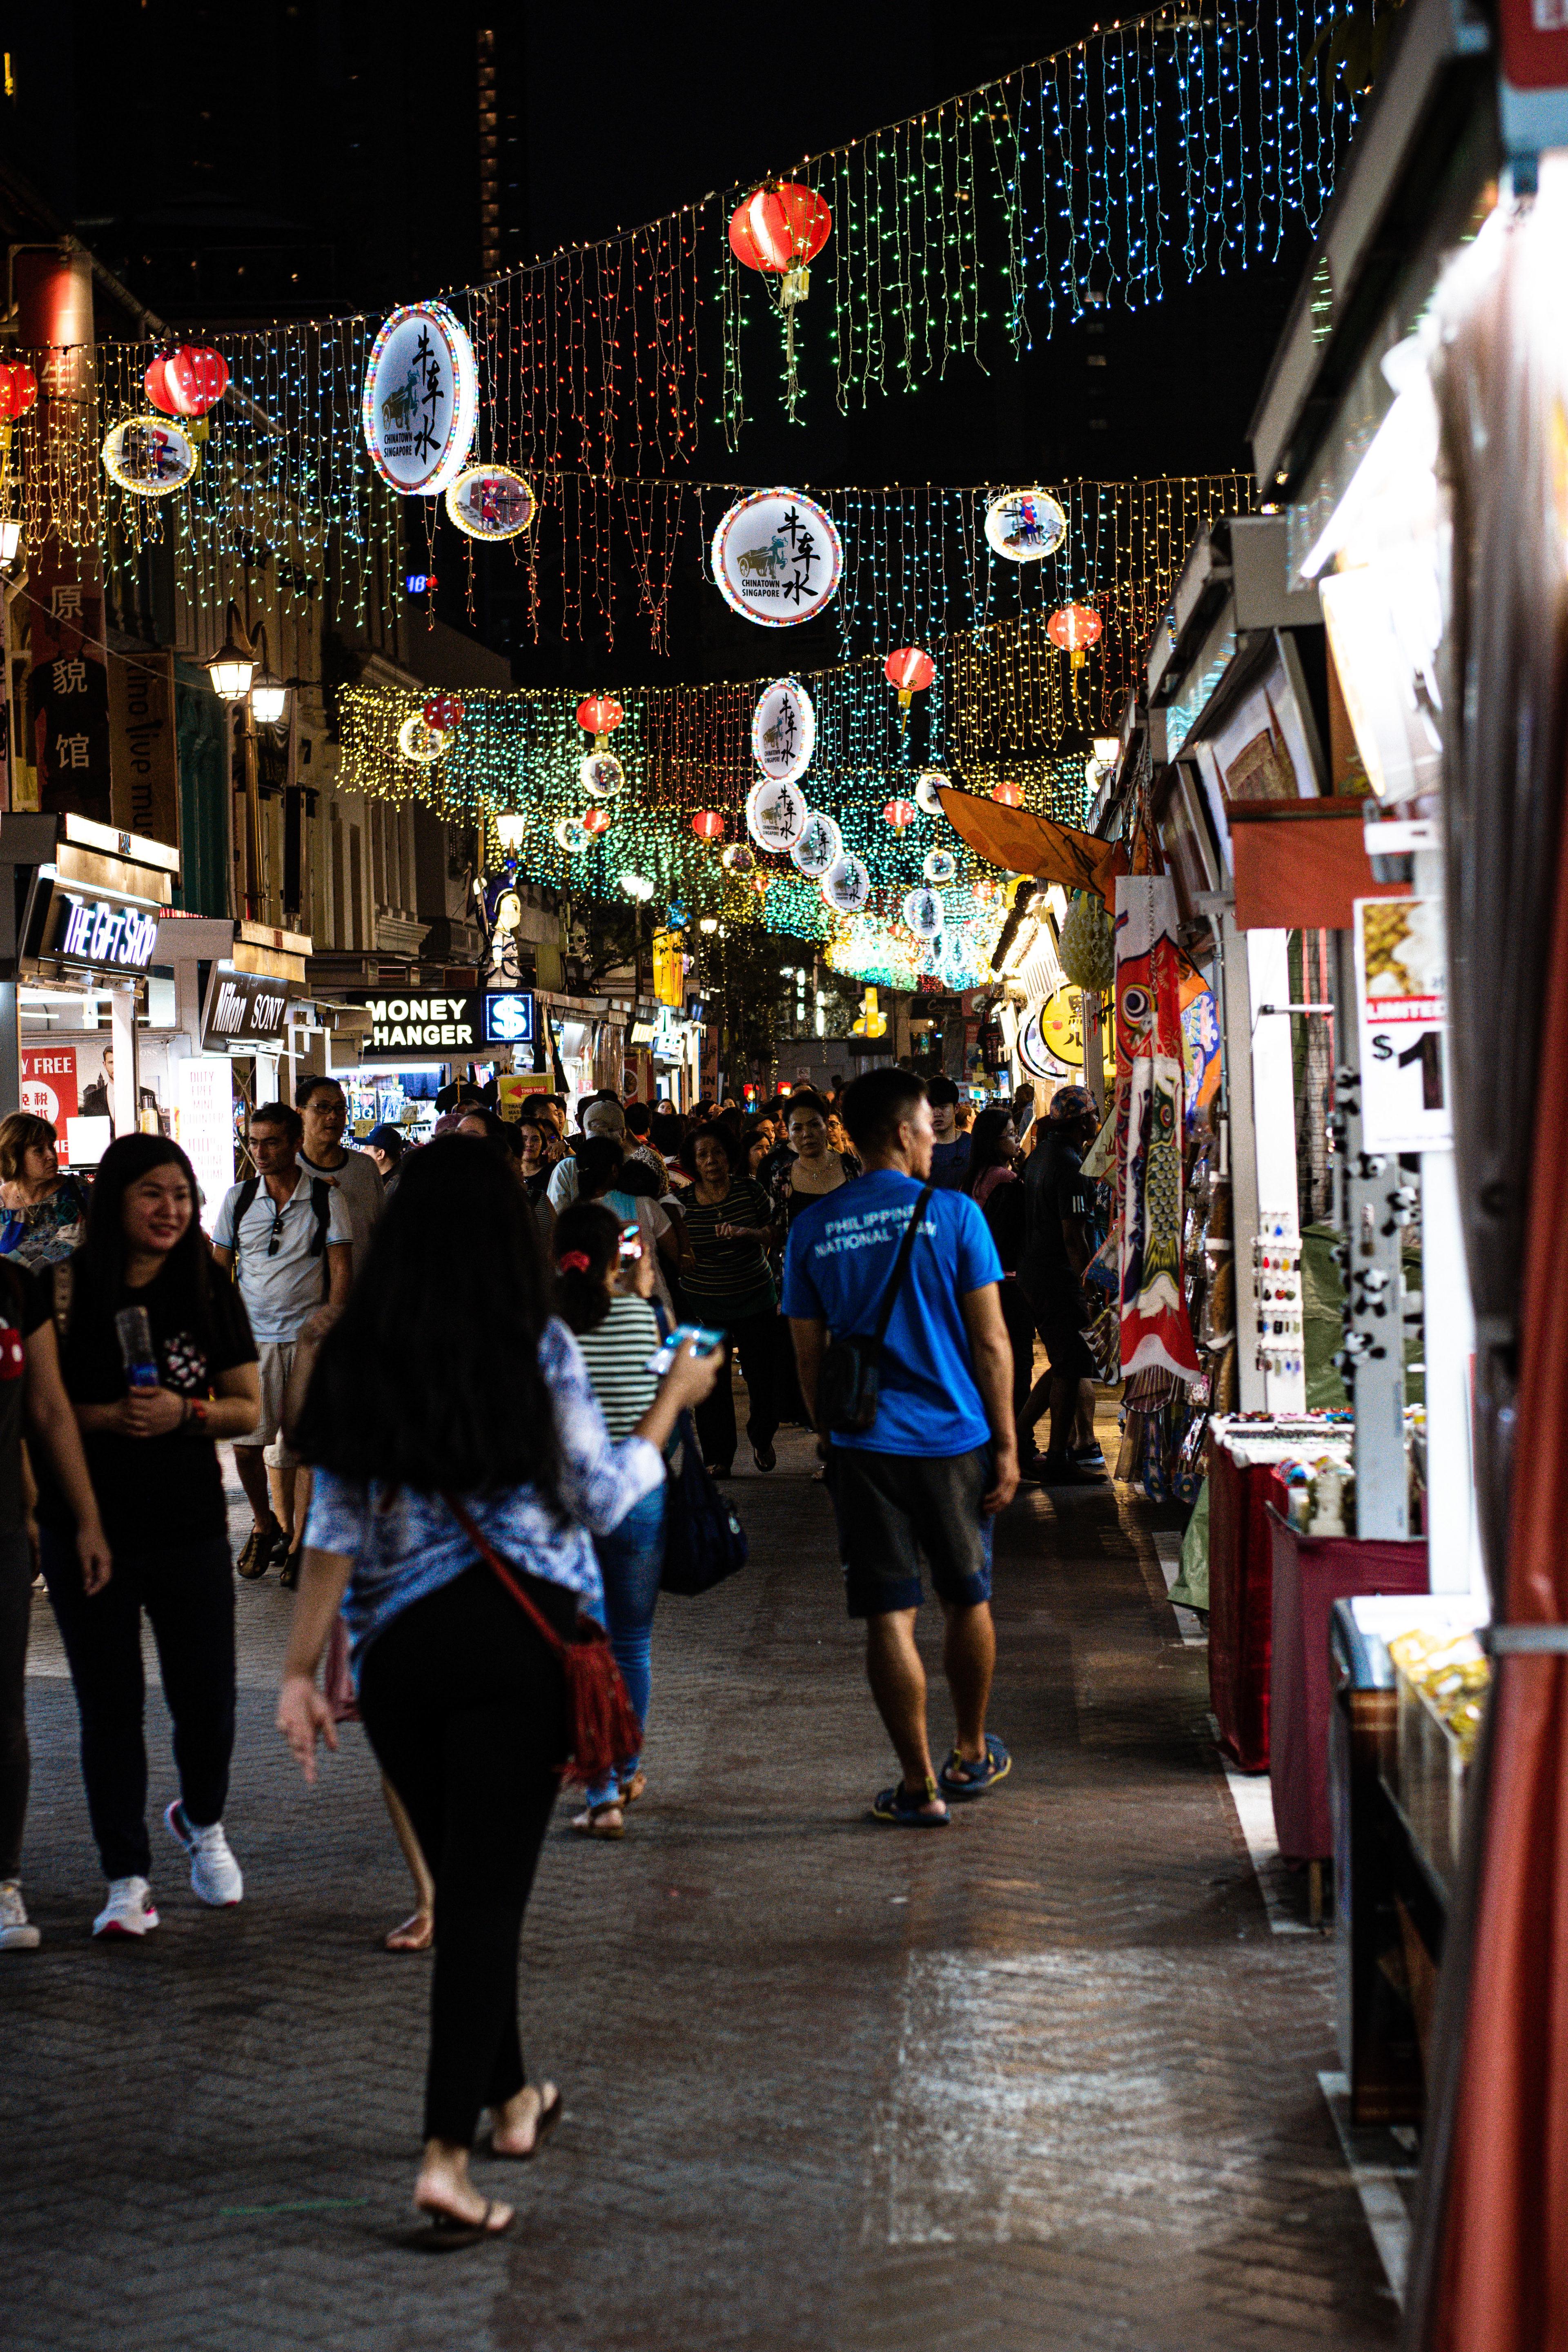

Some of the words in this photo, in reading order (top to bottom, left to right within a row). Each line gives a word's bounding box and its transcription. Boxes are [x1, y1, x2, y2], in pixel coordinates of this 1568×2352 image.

[412, 325, 444, 465] 牛车水
[384, 432, 412, 445] CHINATOWN
[384, 445, 412, 458] SINGAPORE
[777, 506, 820, 606] 牛车水
[742, 579, 780, 588] CHINATOWN
[742, 589, 780, 597] SINGAPORE
[780, 693, 797, 766] 牛车水
[778, 784, 797, 841] 牛车水
[64, 893, 95, 957] THE
[91, 902, 126, 962] GIFT
[119, 907, 157, 967] SHOP
[212, 982, 247, 1033] Nikon
[250, 993, 285, 1030] SONY
[365, 999, 466, 1021] MONEY
[363, 1025, 472, 1047] HANGER
[34, 1057, 73, 1074] FREE
[190, 1071, 214, 1082] DUTY
[192, 1085, 212, 1096] FREE
[194, 1099, 213, 1109] MINI
[815, 1227, 893, 1258] NATIONAL
